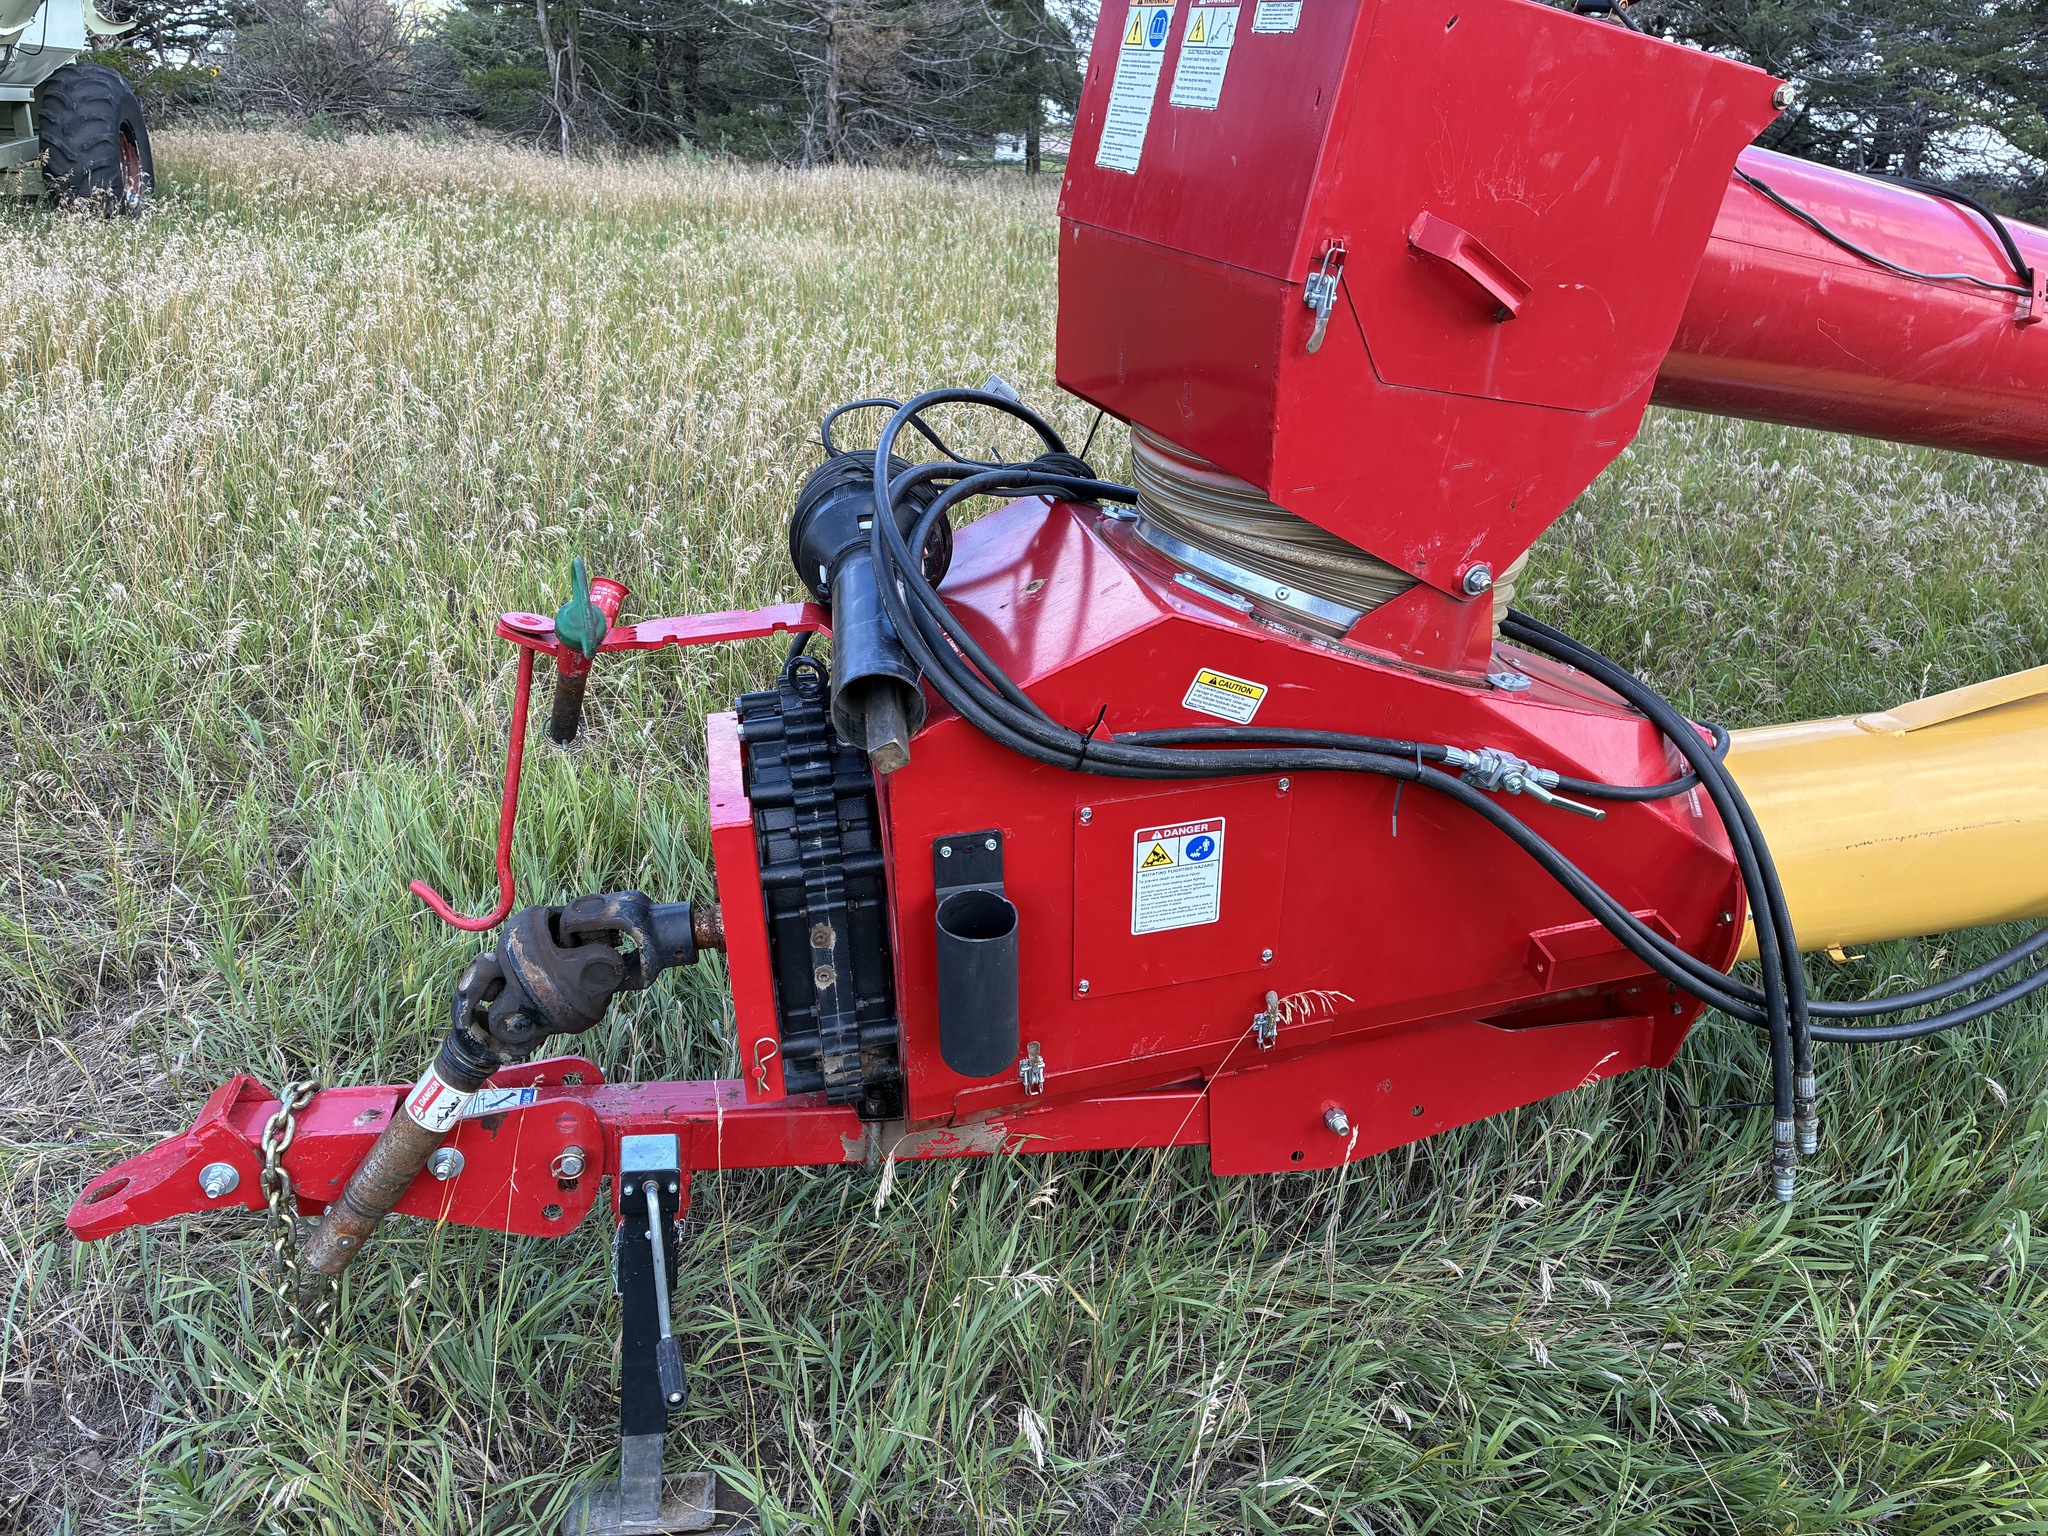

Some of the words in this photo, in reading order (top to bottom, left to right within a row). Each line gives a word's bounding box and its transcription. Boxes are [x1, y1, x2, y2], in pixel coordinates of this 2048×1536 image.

[1218, 680, 1253, 694] CAUTION
[1164, 824, 1208, 837] DANGER
[418, 1080, 440, 1107] DANGER
